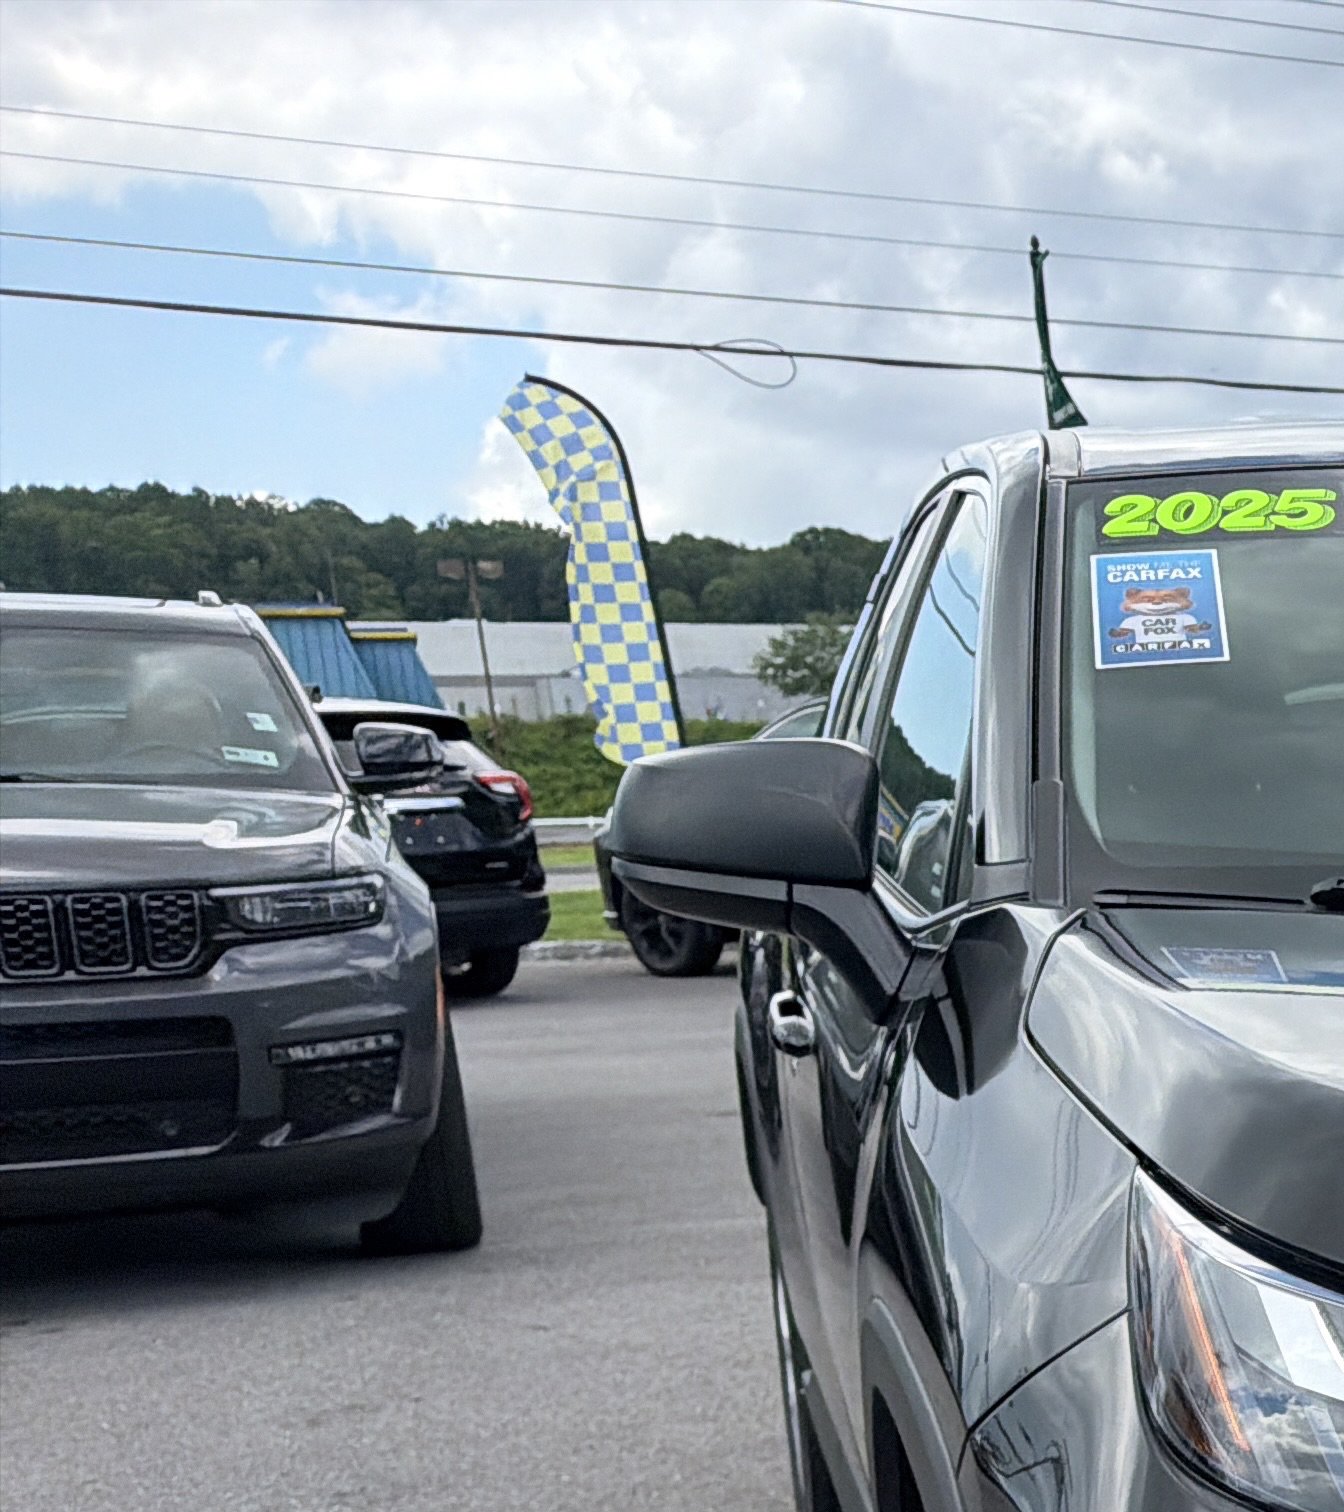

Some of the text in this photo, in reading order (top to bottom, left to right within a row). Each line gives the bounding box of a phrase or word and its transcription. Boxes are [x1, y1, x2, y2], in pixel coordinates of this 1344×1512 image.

[1102, 489, 1336, 538] 2025
[1107, 563, 1150, 572] SHOW
[1107, 567, 1202, 583] CARFAX
[1141, 618, 1177, 627] CAR
[1143, 626, 1177, 636] FOX
[1112, 639, 1211, 654] CARFAX
